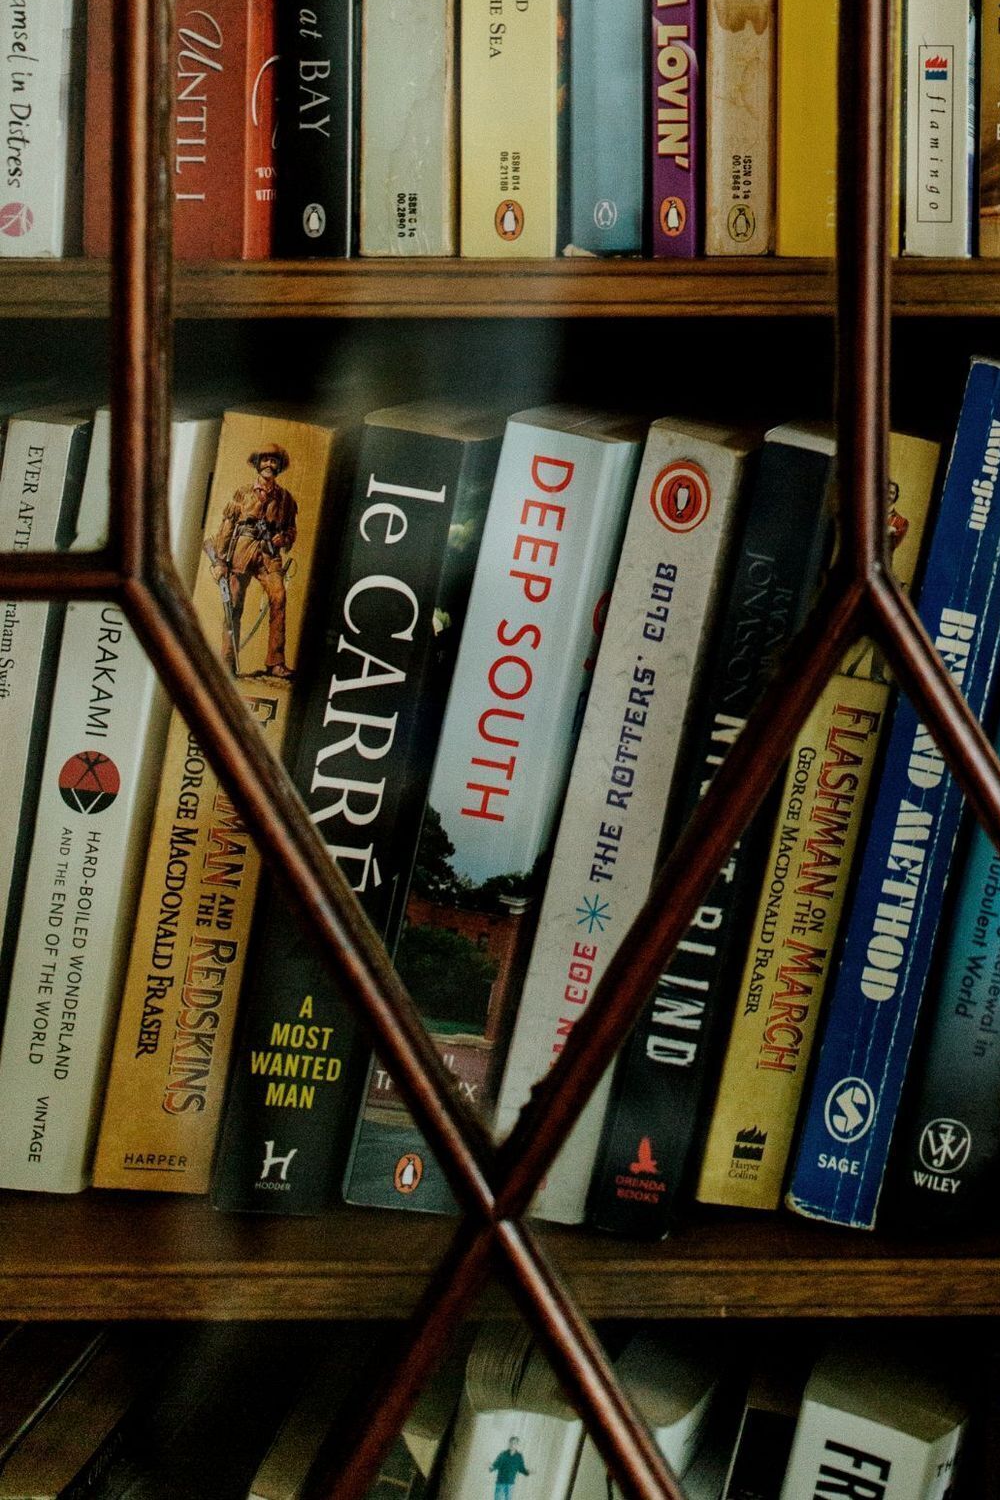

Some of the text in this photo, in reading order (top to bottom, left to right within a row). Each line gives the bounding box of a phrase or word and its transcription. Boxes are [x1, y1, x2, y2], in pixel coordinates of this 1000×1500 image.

[299, 8, 319, 38] at
[13, 72, 33, 94] in
[657, 26, 690, 169] LOVIN'
[299, 59, 331, 138] BAY
[7, 102, 33, 188] Distress
[359, 473, 446, 544] le
[460, 454, 574, 823] DEEP SOUTH
[590, 821, 624, 883] THE
[643, 562, 678, 643] CLUB
[54, 831, 102, 1080] HARD-BOILED WONDERLAND
[299, 995, 313, 1020] A
[755, 937, 828, 1075] MARCH
[270, 1023, 334, 1049] MOST
[251, 1053, 342, 1083] WANTED
[265, 1082, 316, 1110] MAN
[28, 1095, 50, 1163] VINTAGE
[124, 1153, 188, 1168] HARPER
[728, 1169, 757, 1181] Collins
[818, 1153, 859, 1175] SAGE
[255, 1181, 292, 1191] HODDER
[913, 1171, 961, 1195] WILEY
